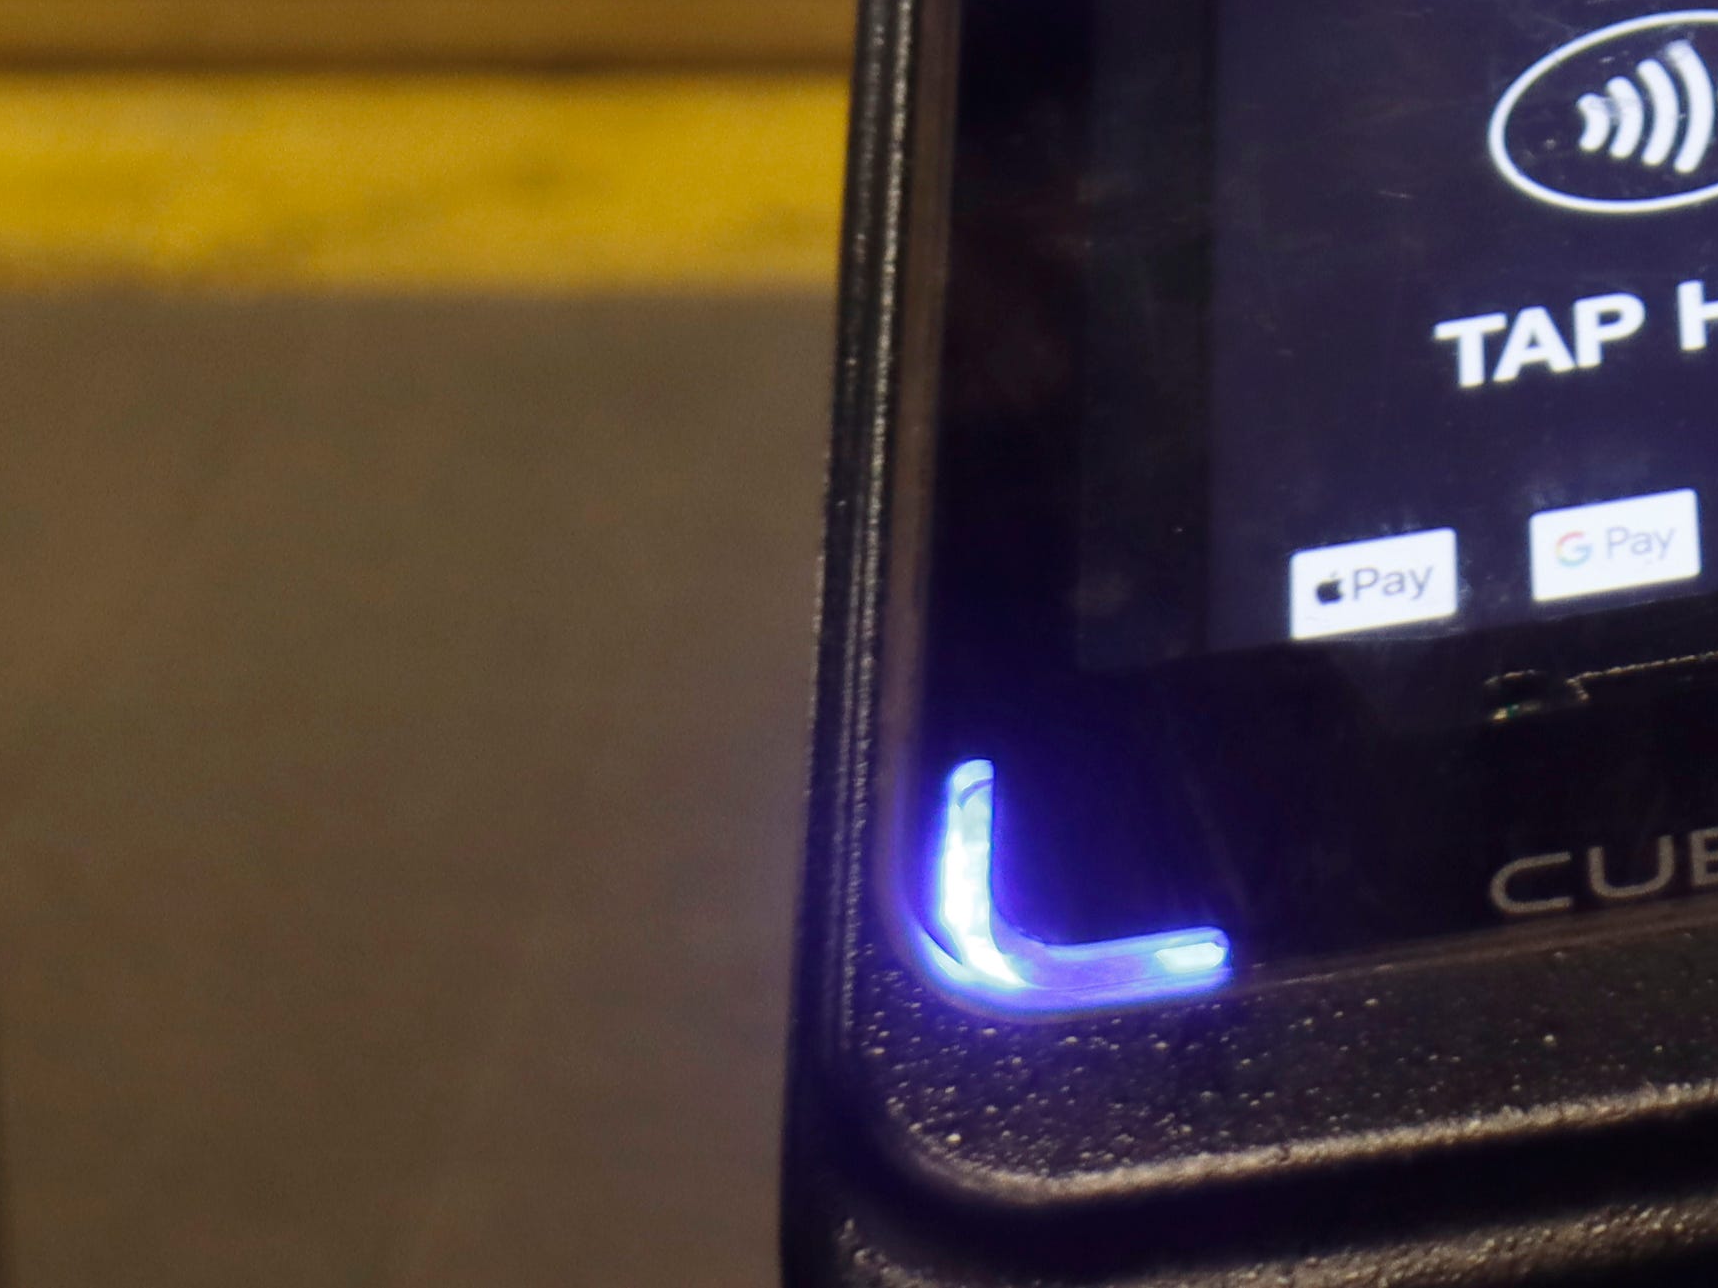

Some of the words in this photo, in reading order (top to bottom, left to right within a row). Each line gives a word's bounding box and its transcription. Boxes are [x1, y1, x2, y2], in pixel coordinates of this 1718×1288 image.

[1433, 293, 1647, 389] TAP
[1605, 524, 1676, 561] Pay
[1351, 565, 1434, 601] Pay
